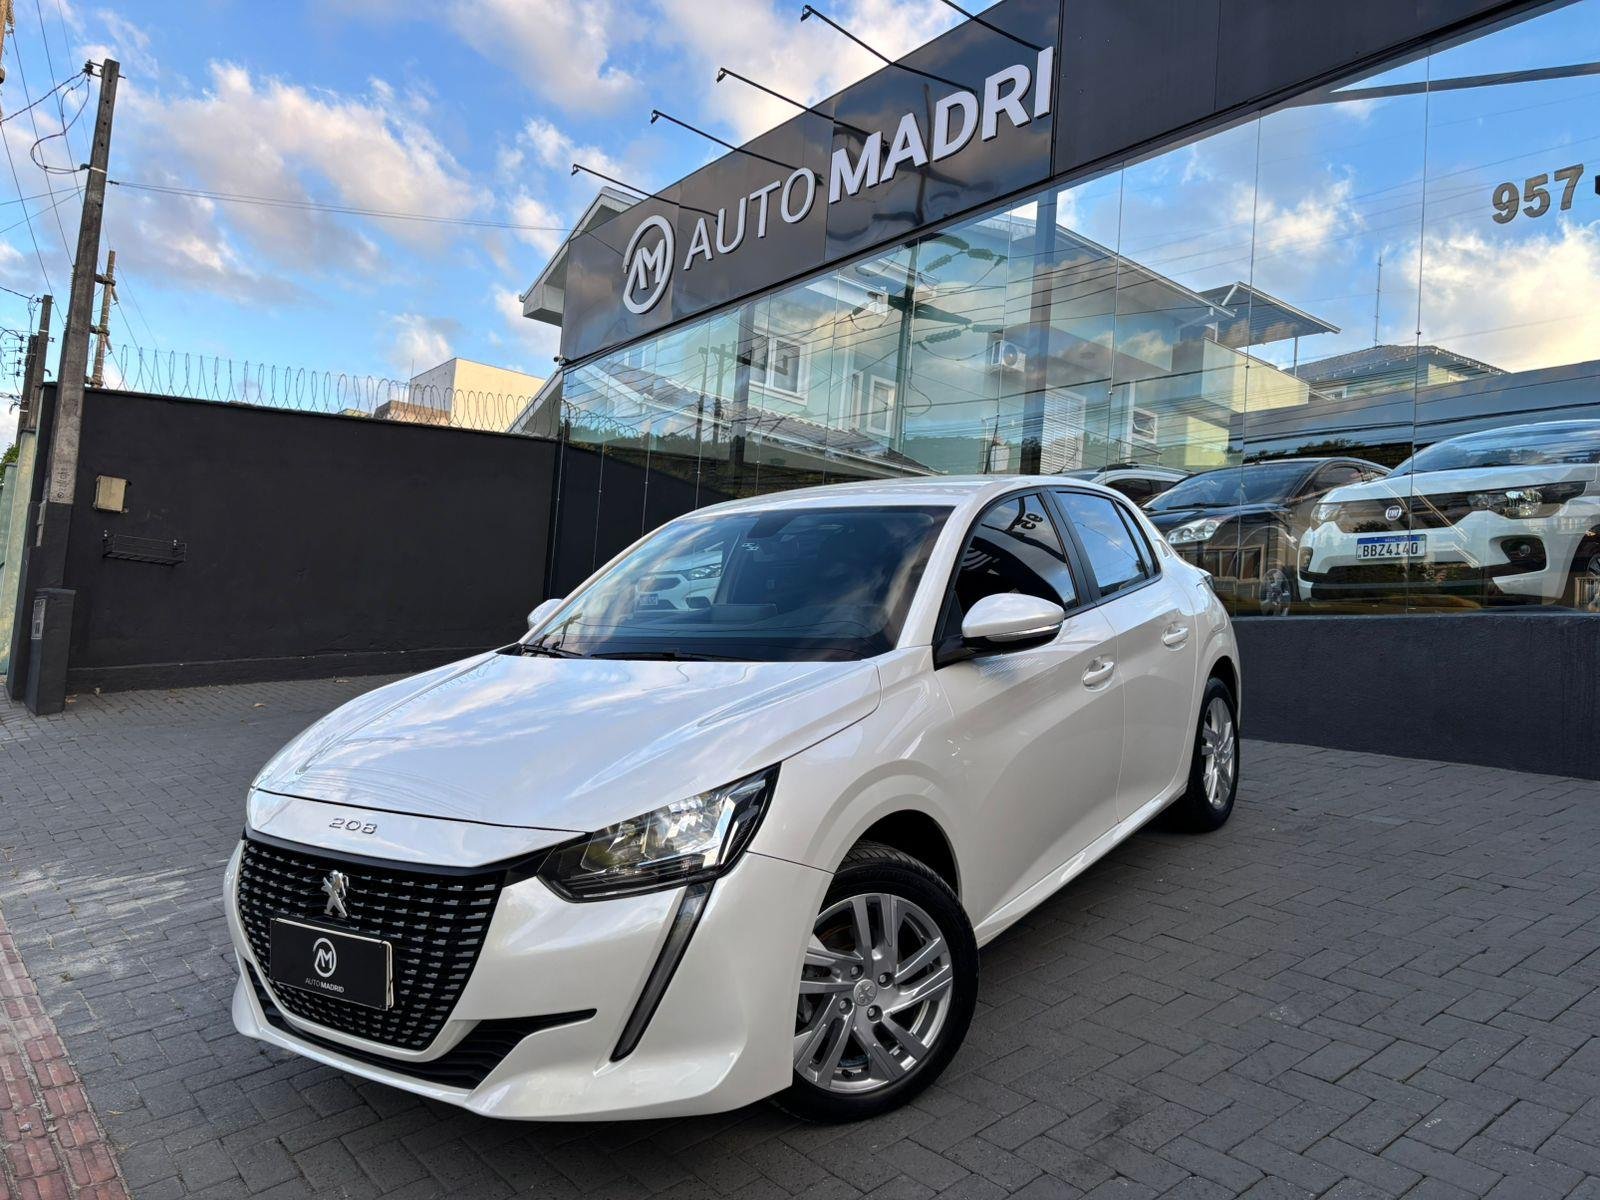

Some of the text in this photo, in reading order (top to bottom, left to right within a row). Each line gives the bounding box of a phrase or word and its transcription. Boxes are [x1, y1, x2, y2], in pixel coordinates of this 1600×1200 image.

[683, 46, 1054, 270] AUTO MADRI
[1492, 163, 1584, 224] 957
[328, 818, 378, 834] 208
[305, 977, 345, 993] AUTO MADRID
